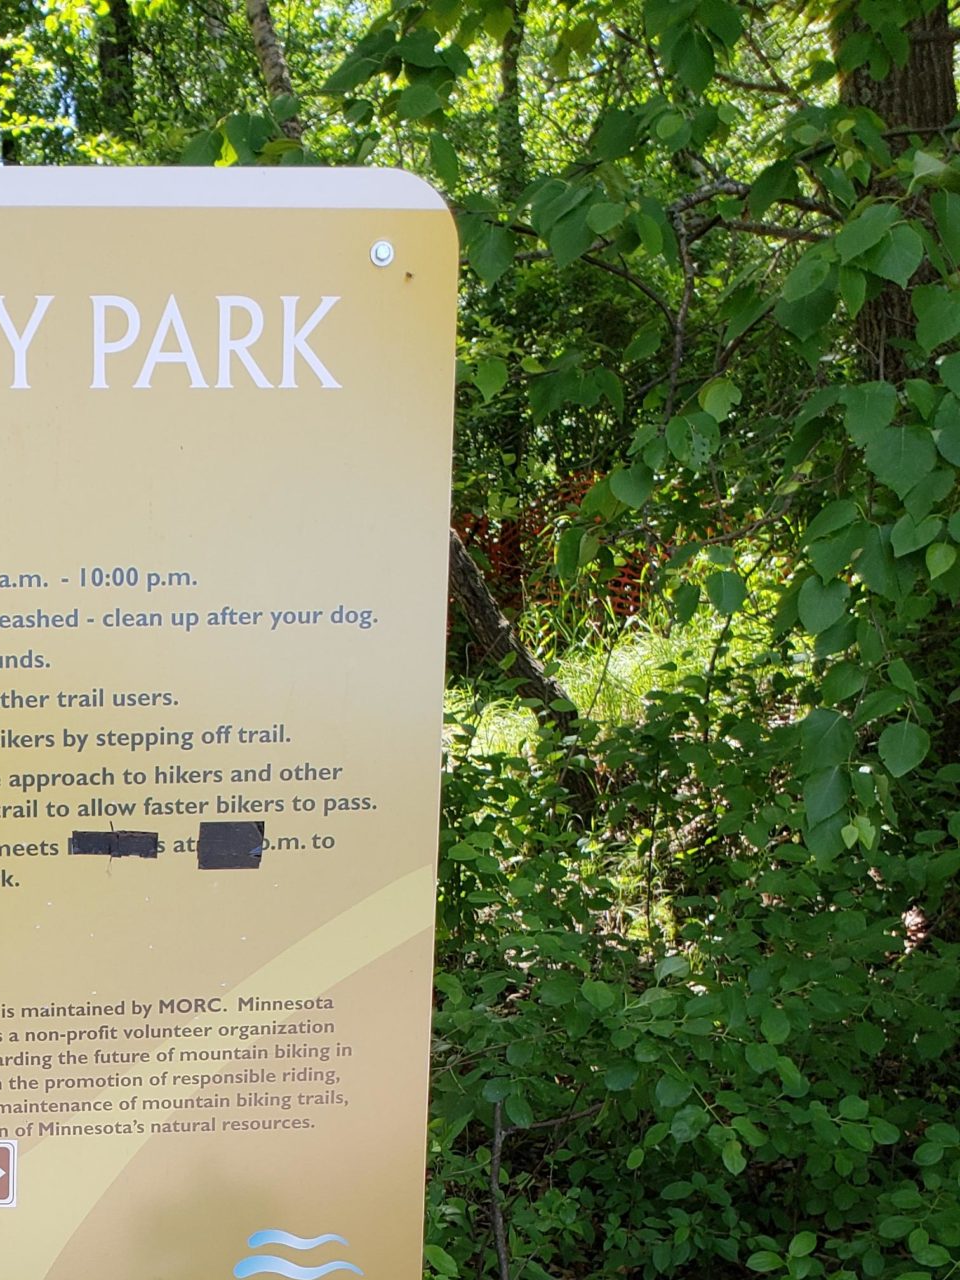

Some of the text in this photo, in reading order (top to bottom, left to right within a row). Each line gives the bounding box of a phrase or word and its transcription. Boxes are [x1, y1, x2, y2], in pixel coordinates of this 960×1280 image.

[89, 293, 342, 389] PARK
[80, 566, 138, 587] 10:00
[146, 572, 197, 592] p.m.
[102, 607, 162, 627] clean
[171, 612, 199, 632] up
[206, 605, 263, 626] after
[270, 610, 323, 630] your
[330, 604, 378, 629] dog.
[56, 687, 104, 708] trail
[112, 692, 178, 707] users.
[63, 728, 88, 753] by
[96, 726, 194, 752] stepping
[201, 724, 233, 744] off
[237, 723, 291, 743] trail.
[8, 766, 114, 793] approach
[122, 768, 146, 785] to
[154, 765, 223, 784] hikers
[230, 763, 271, 782] and
[279, 762, 343, 781] other
[45, 801, 70, 817] to
[77, 798, 136, 817] allow
[143, 796, 209, 815] faster
[216, 794, 284, 814] bikers
[291, 795, 316, 812] to
[323, 797, 377, 816] pass.
[173, 839, 193, 853] at
[312, 833, 335, 849] to
[1, 1003, 15, 1018] is
[21, 1000, 125, 1018] maintained
[131, 999, 152, 1019] by
[158, 997, 227, 1014] MORC.
[238, 996, 334, 1012] Minnesota
[8, 1031, 20, 1042] a
[24, 1024, 118, 1045] non-profit
[122, 1023, 213, 1039] volunteer
[218, 1018, 334, 1040] organization
[57, 1050, 88, 1065] the
[93, 1049, 150, 1064] future
[156, 1046, 176, 1062] of
[179, 1044, 268, 1062] mountain
[274, 1043, 330, 1062] biking
[336, 1042, 352, 1056] in
[8, 1075, 39, 1090] the
[44, 1072, 143, 1094] promotion
[148, 1071, 168, 1086] of
[172, 1068, 276, 1089] responsible
[282, 1066, 340, 1085] riding,
[118, 1095, 138, 1111] of
[142, 1093, 230, 1110] mountain
[236, 1091, 292, 1110] biking
[297, 1089, 348, 1106] trails,
[13, 1122, 34, 1140] of
[38, 1119, 144, 1136] Minnesota's
[150, 1116, 216, 1133] natural
[222, 1118, 315, 1131] resources.
